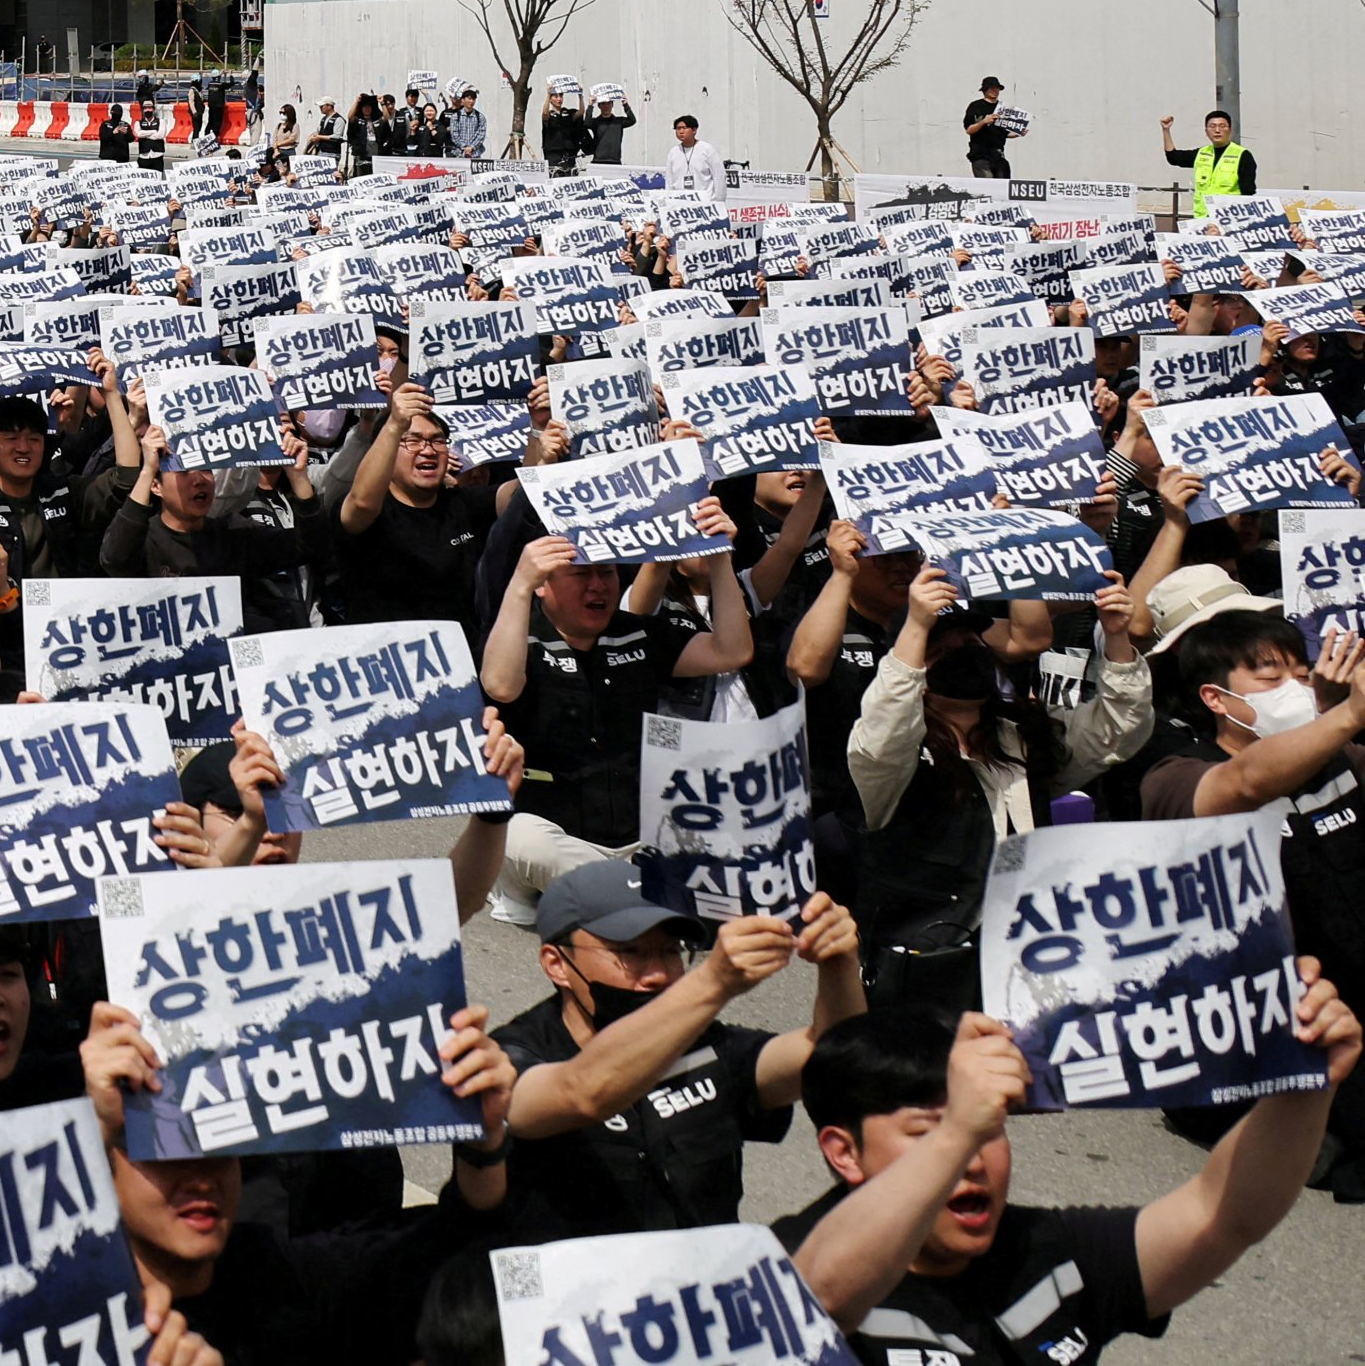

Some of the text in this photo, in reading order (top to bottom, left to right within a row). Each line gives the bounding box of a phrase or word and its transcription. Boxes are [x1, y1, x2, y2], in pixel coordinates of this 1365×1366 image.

[741, 172, 806, 185] 전국삼성전자노동조합
[1011, 184, 1131, 198] NSEU 전국삼성전자노동조합
[740, 204, 791, 222] 생존권 사수
[1076, 219, 1100, 238] 장난
[775, 316, 891, 365] 상한폐지
[836, 443, 967, 500] 상한폐지
[959, 538, 1106, 598] 실현하자
[40, 585, 219, 670] 상한폐지
[262, 630, 451, 735] 상한폐지
[607, 649, 646, 667] SELU
[300, 716, 488, 827] 실현하자
[1314, 808, 1357, 836] SELU
[1007, 827, 1268, 975] 상한폐지
[134, 874, 426, 1022] 상한폐지
[1049, 955, 1306, 1104] 실현하자
[180, 1002, 453, 1152] 실현하자
[648, 1078, 718, 1119] SELU
